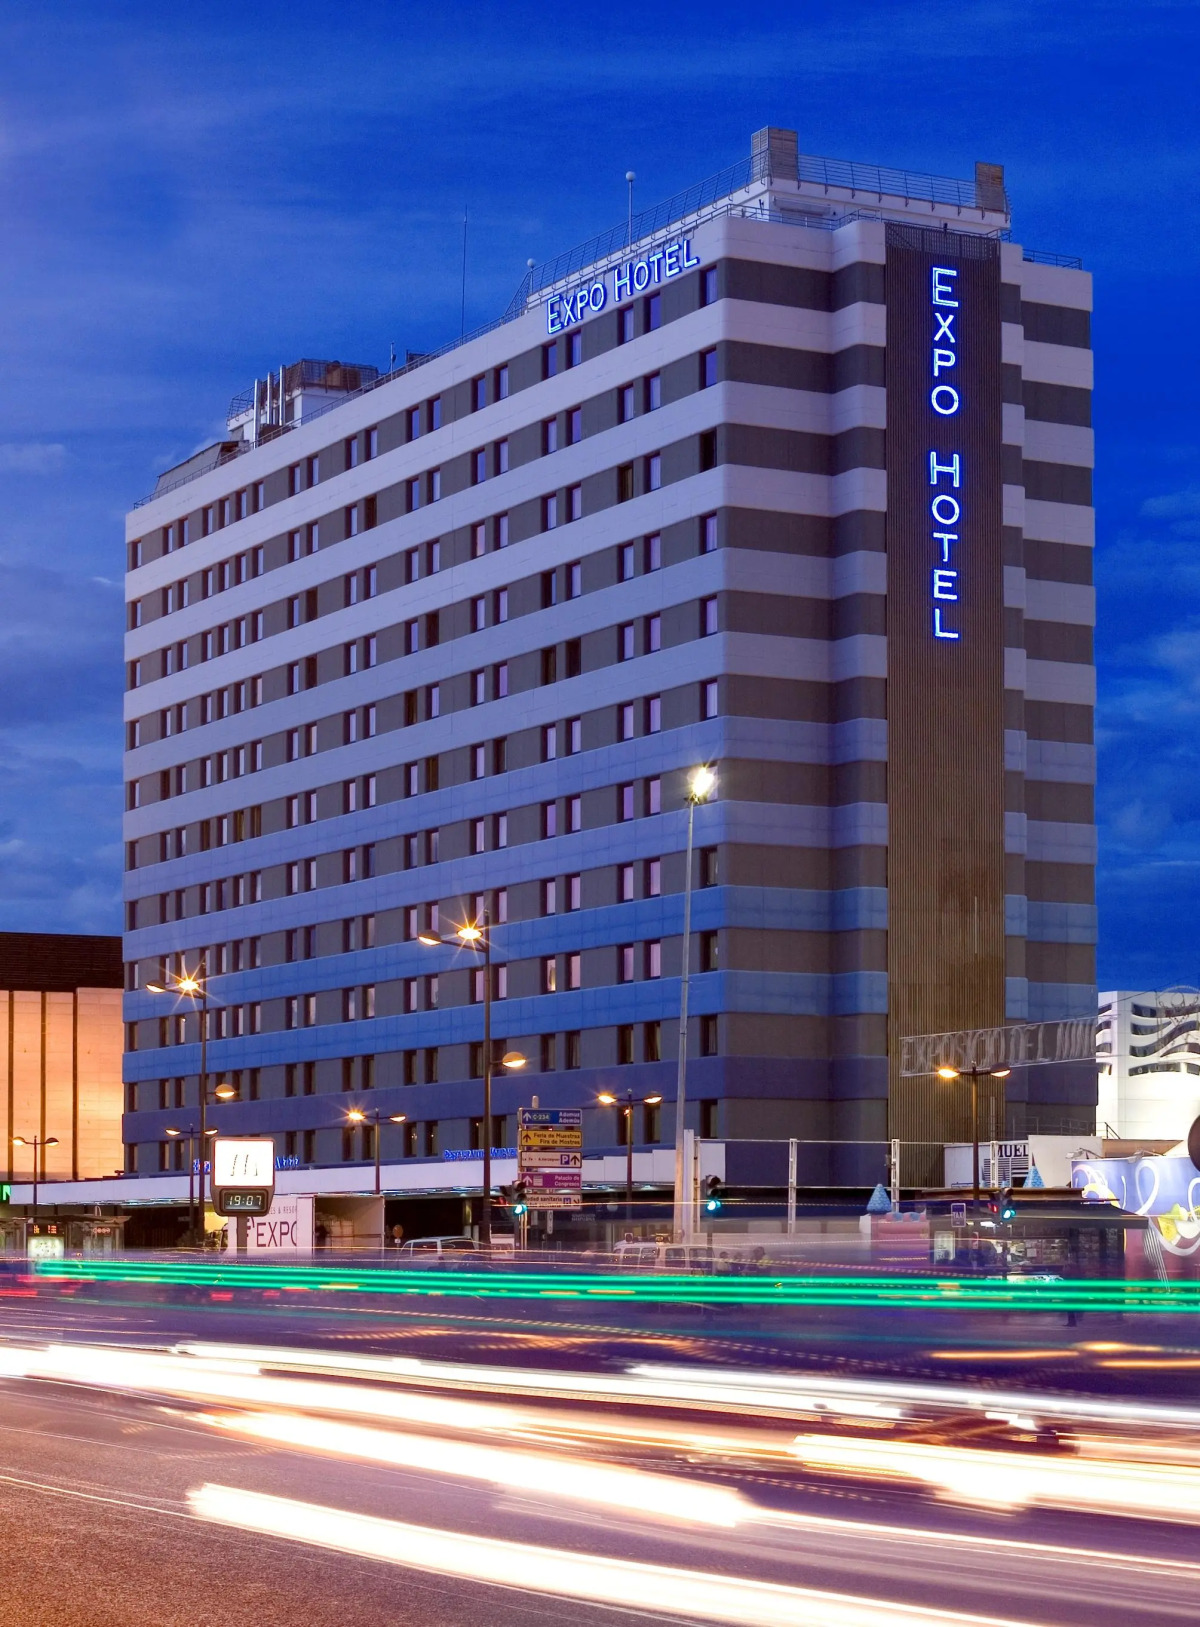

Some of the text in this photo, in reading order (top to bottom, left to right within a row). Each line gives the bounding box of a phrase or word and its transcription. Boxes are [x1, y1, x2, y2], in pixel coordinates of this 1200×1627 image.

[547, 239, 700, 334] EXPO HOTEL
[930, 266, 960, 640] EXPO HOTEL
[561, 1155, 569, 1165] P
[228, 1195, 262, 1206] 19:07
[952, 1211, 964, 1219] TAXI
